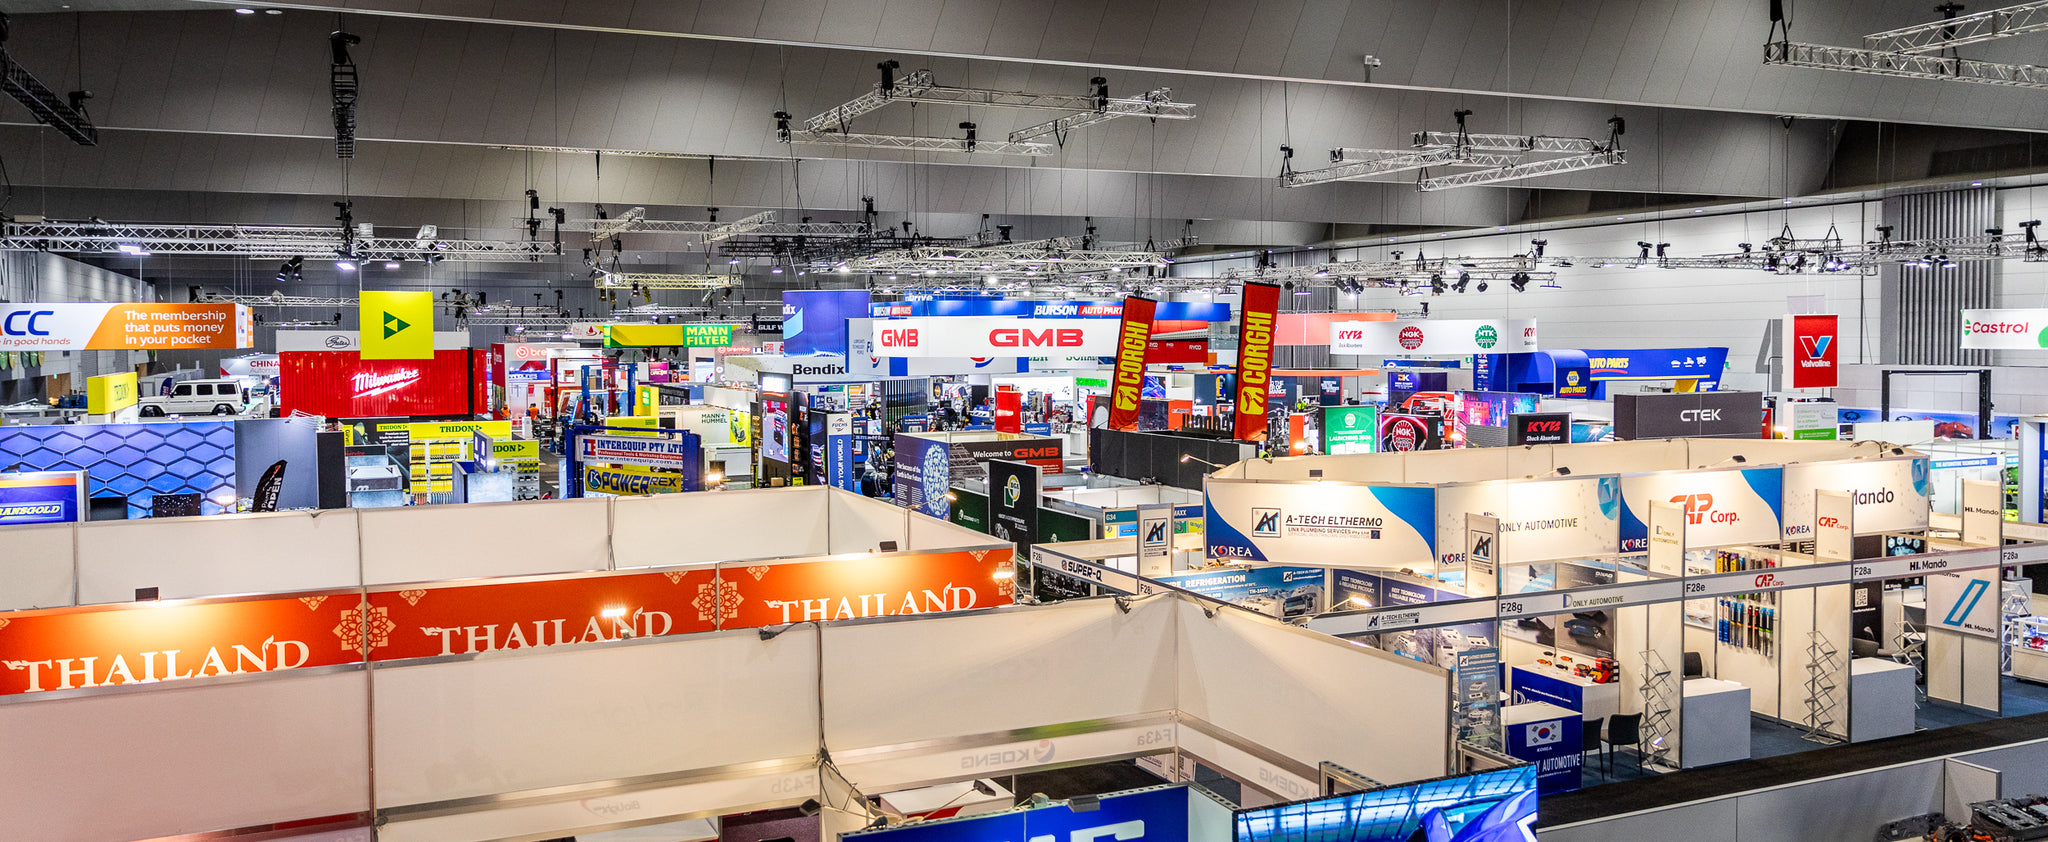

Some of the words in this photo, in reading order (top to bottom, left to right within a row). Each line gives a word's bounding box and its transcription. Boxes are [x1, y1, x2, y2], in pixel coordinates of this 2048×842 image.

[124, 310, 147, 320] The
[150, 310, 226, 322] membership
[1034, 305, 1078, 316] BURSON
[125, 322, 150, 332] that
[154, 323, 180, 334] puts
[184, 324, 224, 334] money
[686, 326, 728, 335] MANN
[1972, 322, 2029, 334] Castrol
[125, 334, 136, 344] in
[140, 336, 168, 346] your
[172, 334, 211, 346] pocket
[686, 336, 728, 345] FILTER
[881, 329, 918, 347] GMB
[989, 329, 1084, 347] GMB
[1339, 330, 1362, 340] KYB
[14, 338, 39, 346] good
[1242, 310, 1272, 384] CORGHI
[530, 348, 547, 356] bre
[1118, 321, 1148, 384] CORGHI
[1755, 319, 1783, 392] 4
[250, 360, 280, 368] CHINA
[1606, 358, 1629, 368] PARTS
[1801, 360, 1830, 368] Valvoline
[792, 364, 844, 375] Bendix
[350, 368, 420, 392] Milwaukee
[1560, 386, 1572, 394] AUTO
[1680, 409, 1722, 422] CTEK
[1396, 428, 1411, 436] NGK
[1527, 421, 1561, 432] KYB
[597, 440, 646, 452] INTEREQUIP
[649, 442, 665, 453] PTY
[1014, 447, 1059, 458] GMB
[1710, 510, 1740, 525] Corp.
[1976, 508, 1999, 516] Mando
[1286, 515, 1326, 525] A-TECH
[1328, 516, 1383, 527] ELTHERMO
[1524, 518, 1578, 531] AUTOMOTIVE
[1818, 516, 1838, 528] CAP
[1836, 523, 1850, 531] Corp.
[1786, 525, 1810, 536] KOREA
[1622, 538, 1648, 550] KORE
[1210, 545, 1253, 557] KOREA
[2003, 552, 2018, 560] F28a
[1033, 552, 1042, 563] F28j
[1442, 552, 1466, 565] KORE
[1922, 559, 1947, 570] Mando
[1068, 562, 1102, 582] SUPER-Q
[1854, 567, 1871, 576] F28a
[1185, 574, 1246, 588] REFRIGERATION
[1755, 574, 1774, 588] CAP
[1140, 584, 1152, 594] F28i
[1686, 583, 1706, 593] F28e
[764, 582, 977, 626] THAILAND
[1589, 595, 1624, 606] AUTOMOTIVE
[1500, 603, 1523, 614] F28g
[1398, 612, 1420, 620] ELTHERMO
[421, 606, 672, 658] THAILAND
[1974, 624, 1994, 634] Mando
[2, 634, 310, 692] THAILAND
[1542, 753, 1580, 772] AUTOMOTIVE
